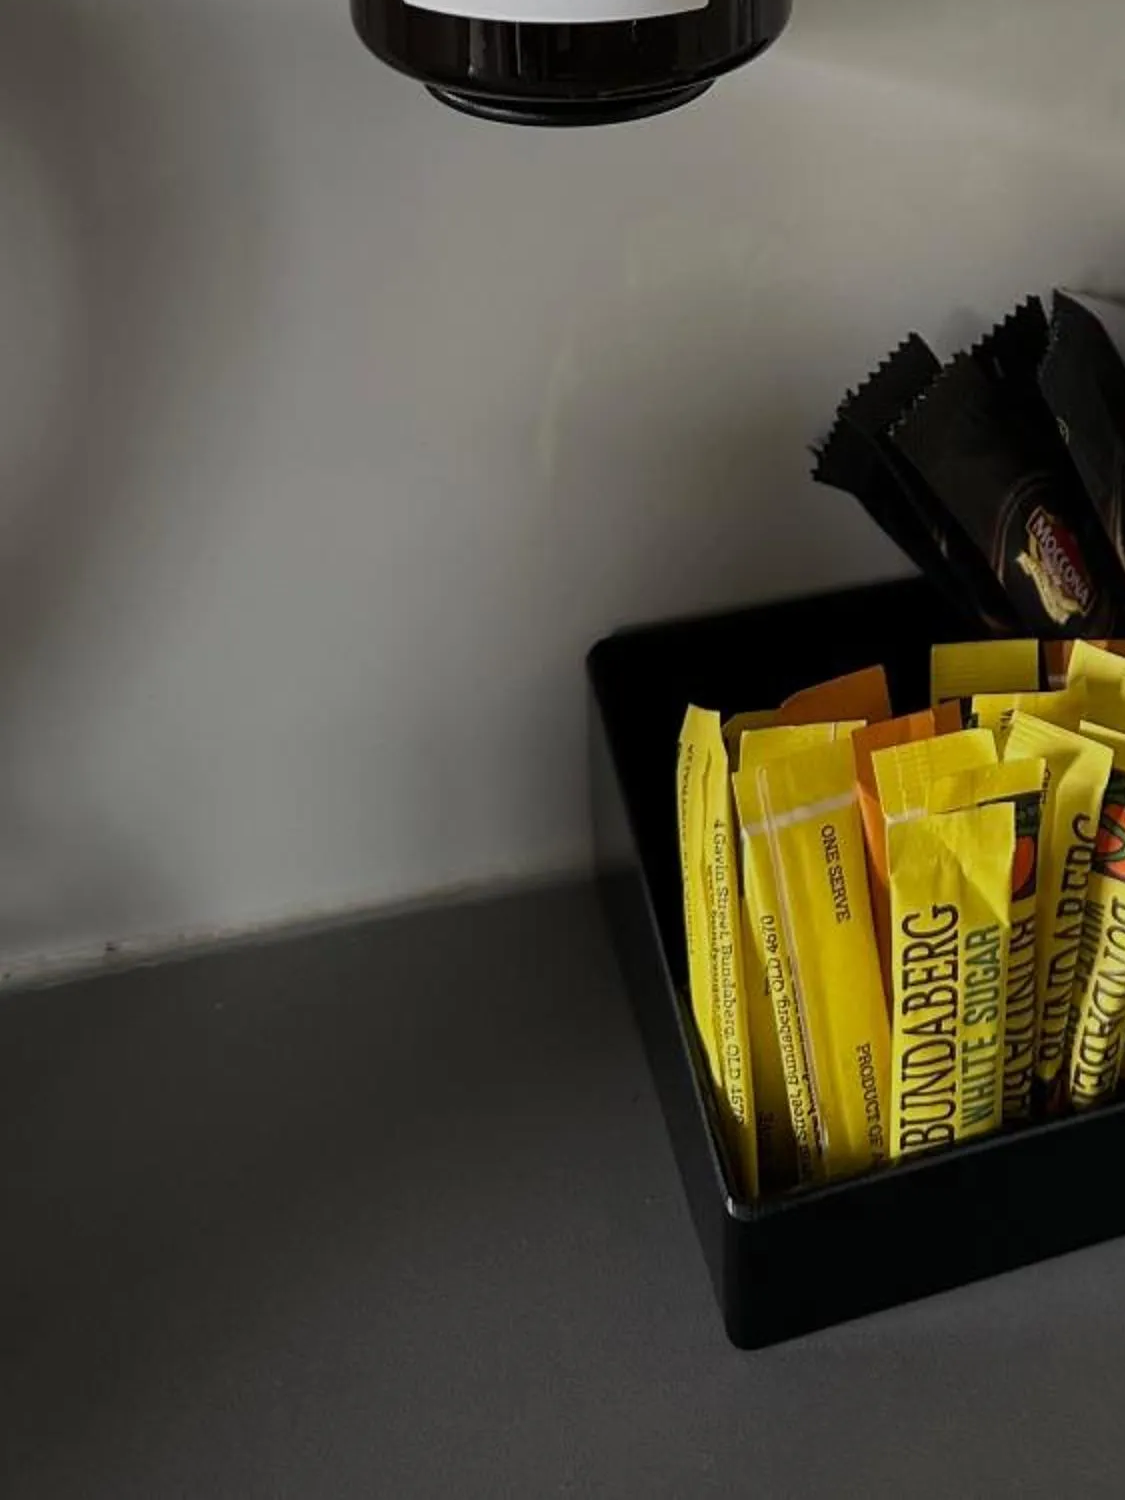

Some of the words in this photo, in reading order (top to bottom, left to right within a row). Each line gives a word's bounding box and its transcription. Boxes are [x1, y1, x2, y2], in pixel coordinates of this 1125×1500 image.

[820, 824, 841, 864] ONE
[829, 864, 851, 925] SERVE
[767, 958, 786, 993] QLD
[962, 923, 1001, 1027] SUGAR
[900, 901, 960, 1151] BUNDABERG
[856, 1041, 882, 1122] PRODUCT
[960, 1032, 998, 1129] WHITE
[867, 1123, 884, 1150] OF
